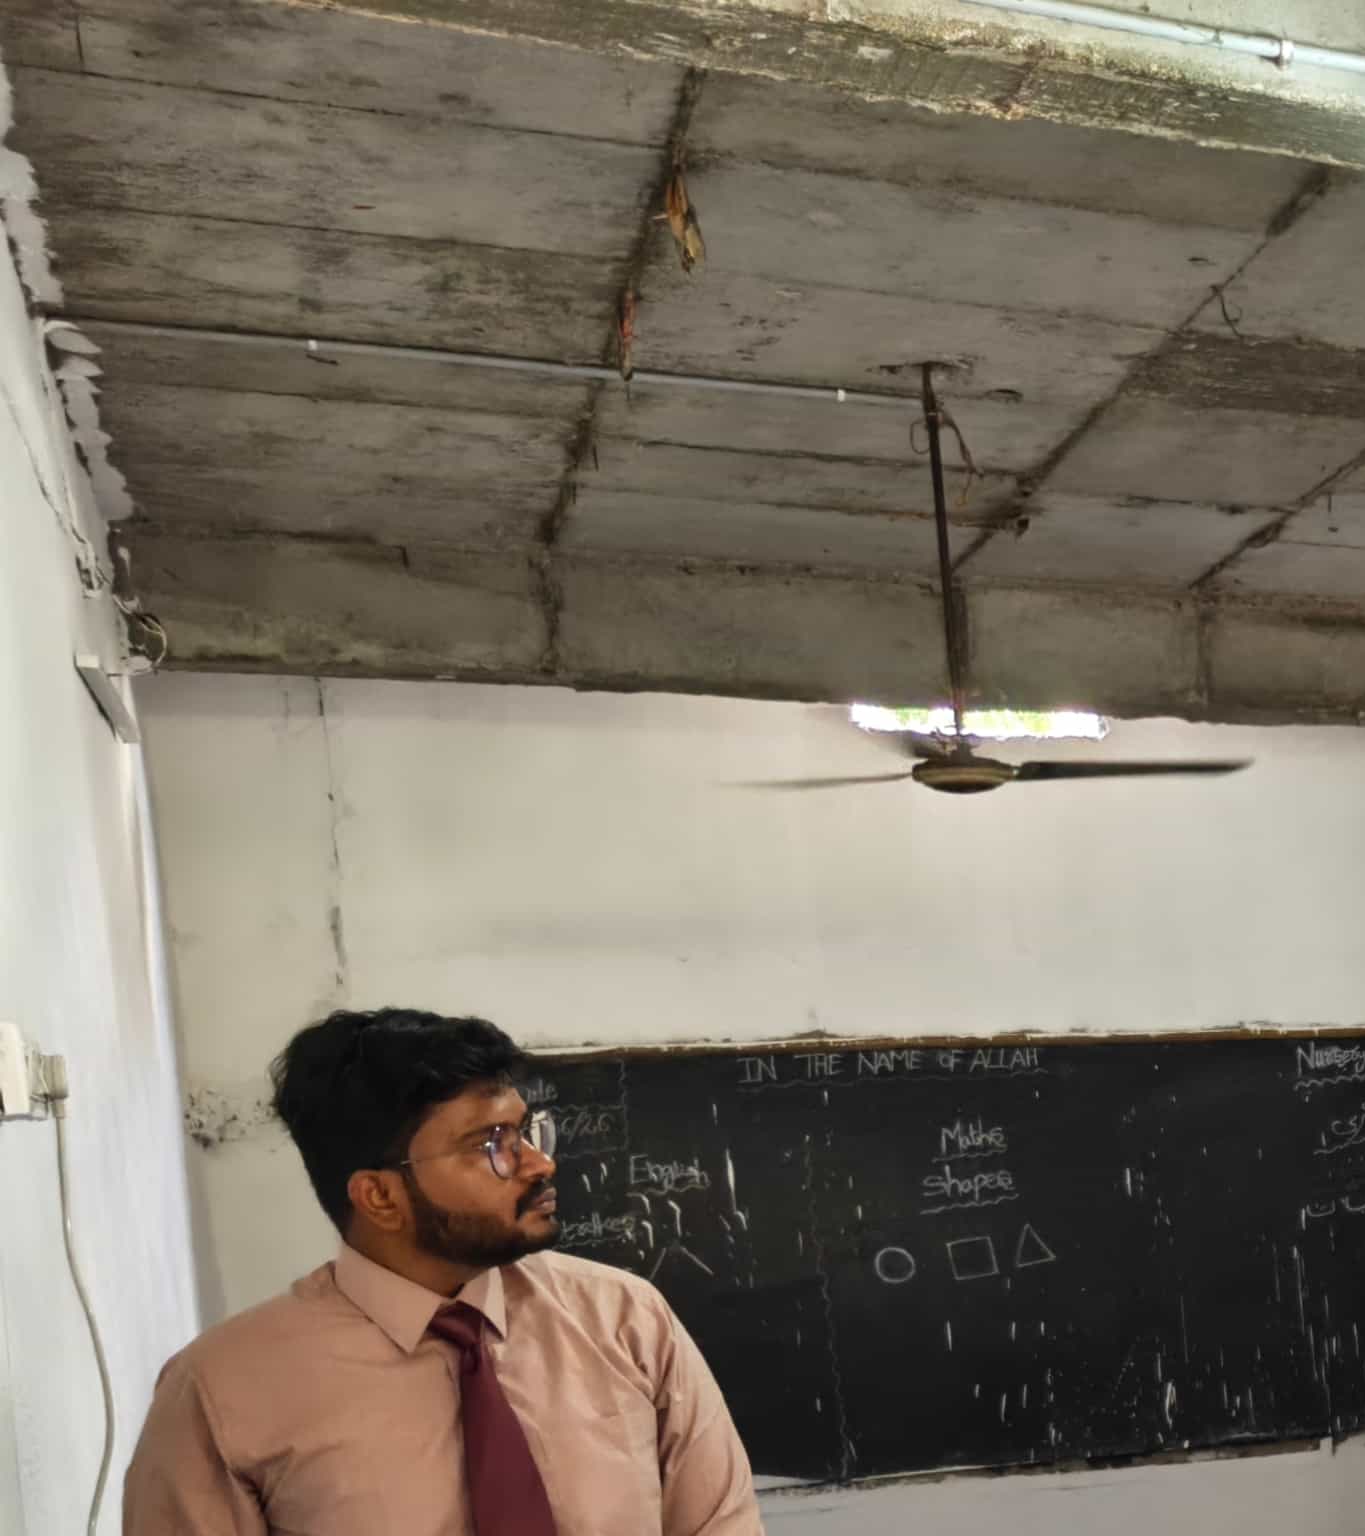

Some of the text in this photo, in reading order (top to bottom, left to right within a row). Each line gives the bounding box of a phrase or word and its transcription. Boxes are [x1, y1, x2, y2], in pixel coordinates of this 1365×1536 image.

[736, 1047, 1040, 1083] IN THE NAME OF ALLAH
